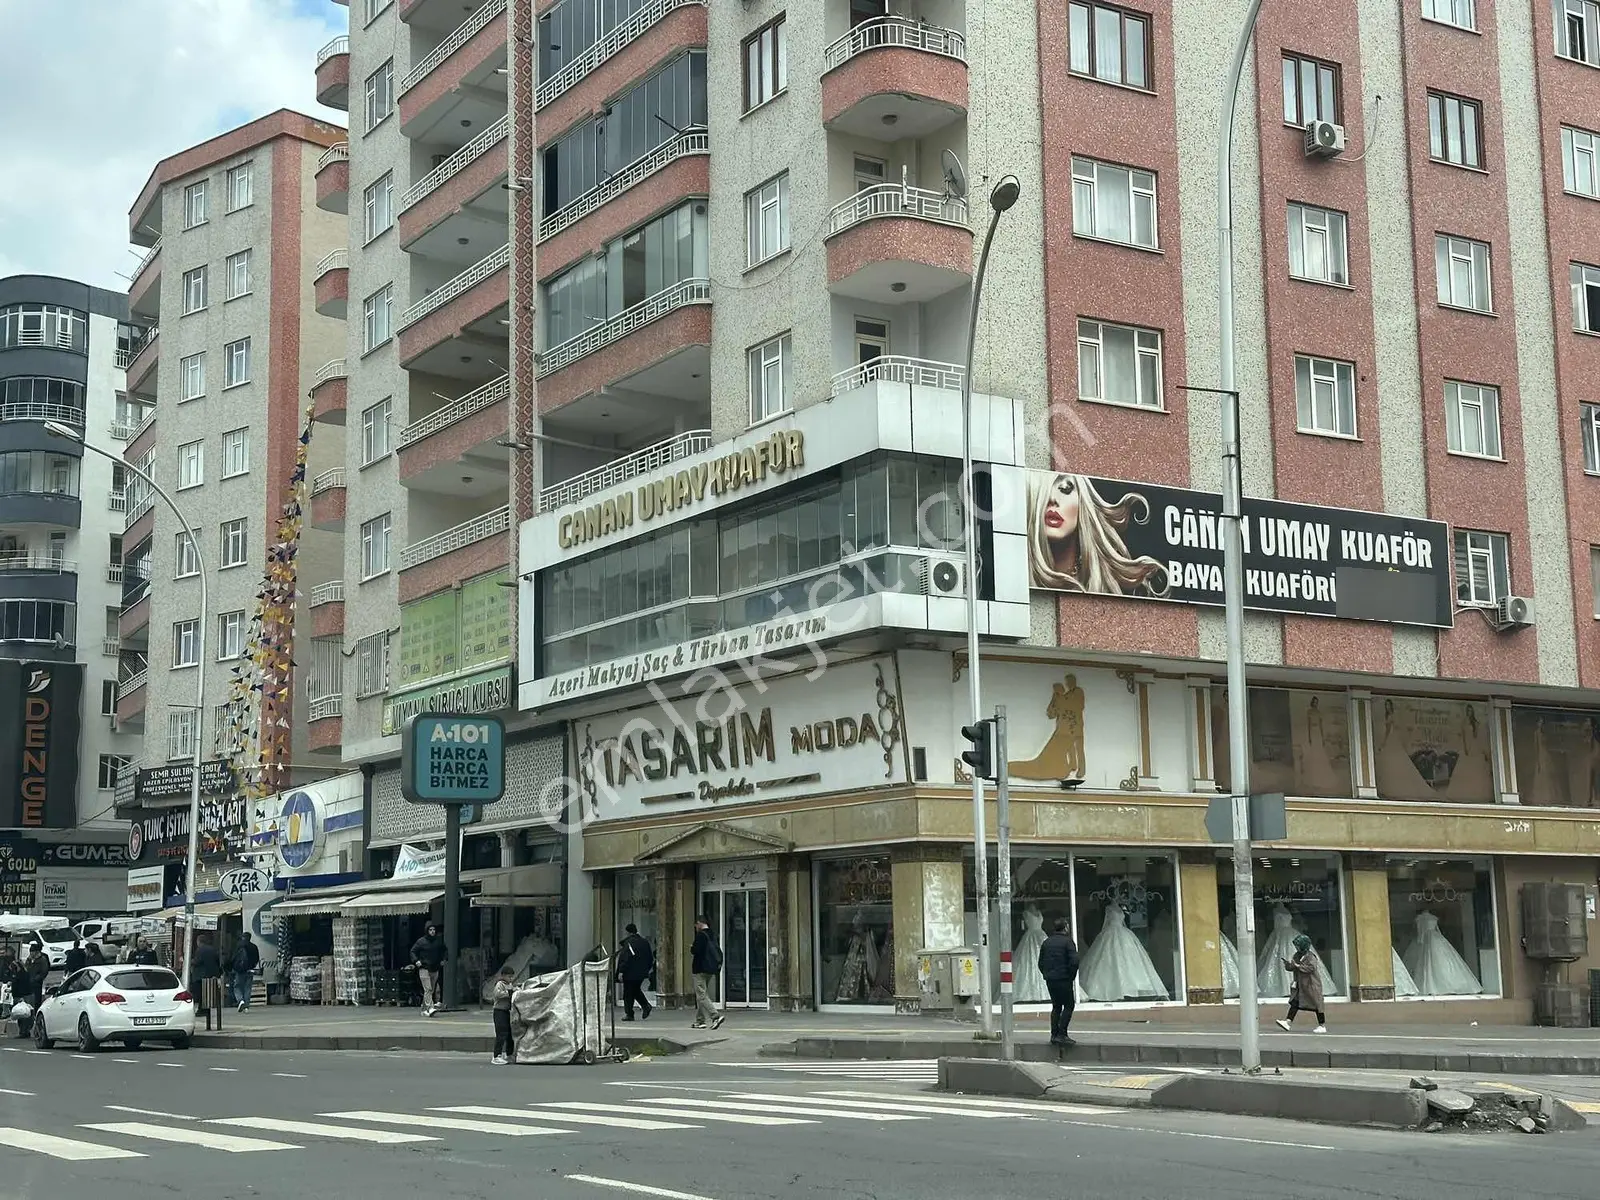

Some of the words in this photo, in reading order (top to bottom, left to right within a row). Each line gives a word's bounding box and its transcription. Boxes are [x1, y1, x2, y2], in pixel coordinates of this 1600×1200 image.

[558, 491, 633, 549] CANAN
[638, 462, 708, 521] UMAY
[709, 429, 804, 496] KUAFÖR
[1259, 516, 1331, 562] UMAY
[1341, 530, 1433, 568] KUAFÖR
[1168, 560, 1223, 592] BAYA
[549, 677, 584, 697] Azeri
[587, 656, 638, 685] Makyaj
[643, 654, 668, 676] Saç
[673, 646, 684, 667] &
[689, 633, 749, 662] Türban
[755, 615, 828, 647] Tasarım
[429, 680, 470, 714] SÜRÜCÜ
[472, 674, 510, 712] KURSU
[20, 698, 50, 826] DENGE
[430, 747, 488, 761] HARCA
[595, 706, 776, 788] TASARIM
[790, 713, 881, 755] MODA
[151, 769, 169, 779] SEMA
[430, 761, 488, 775] HARCA
[144, 818, 165, 843] TUNÇ
[166, 808, 190, 842] İŞİTM
[8, 858, 36, 871] GOLD
[230, 871, 258, 884] 7/24
